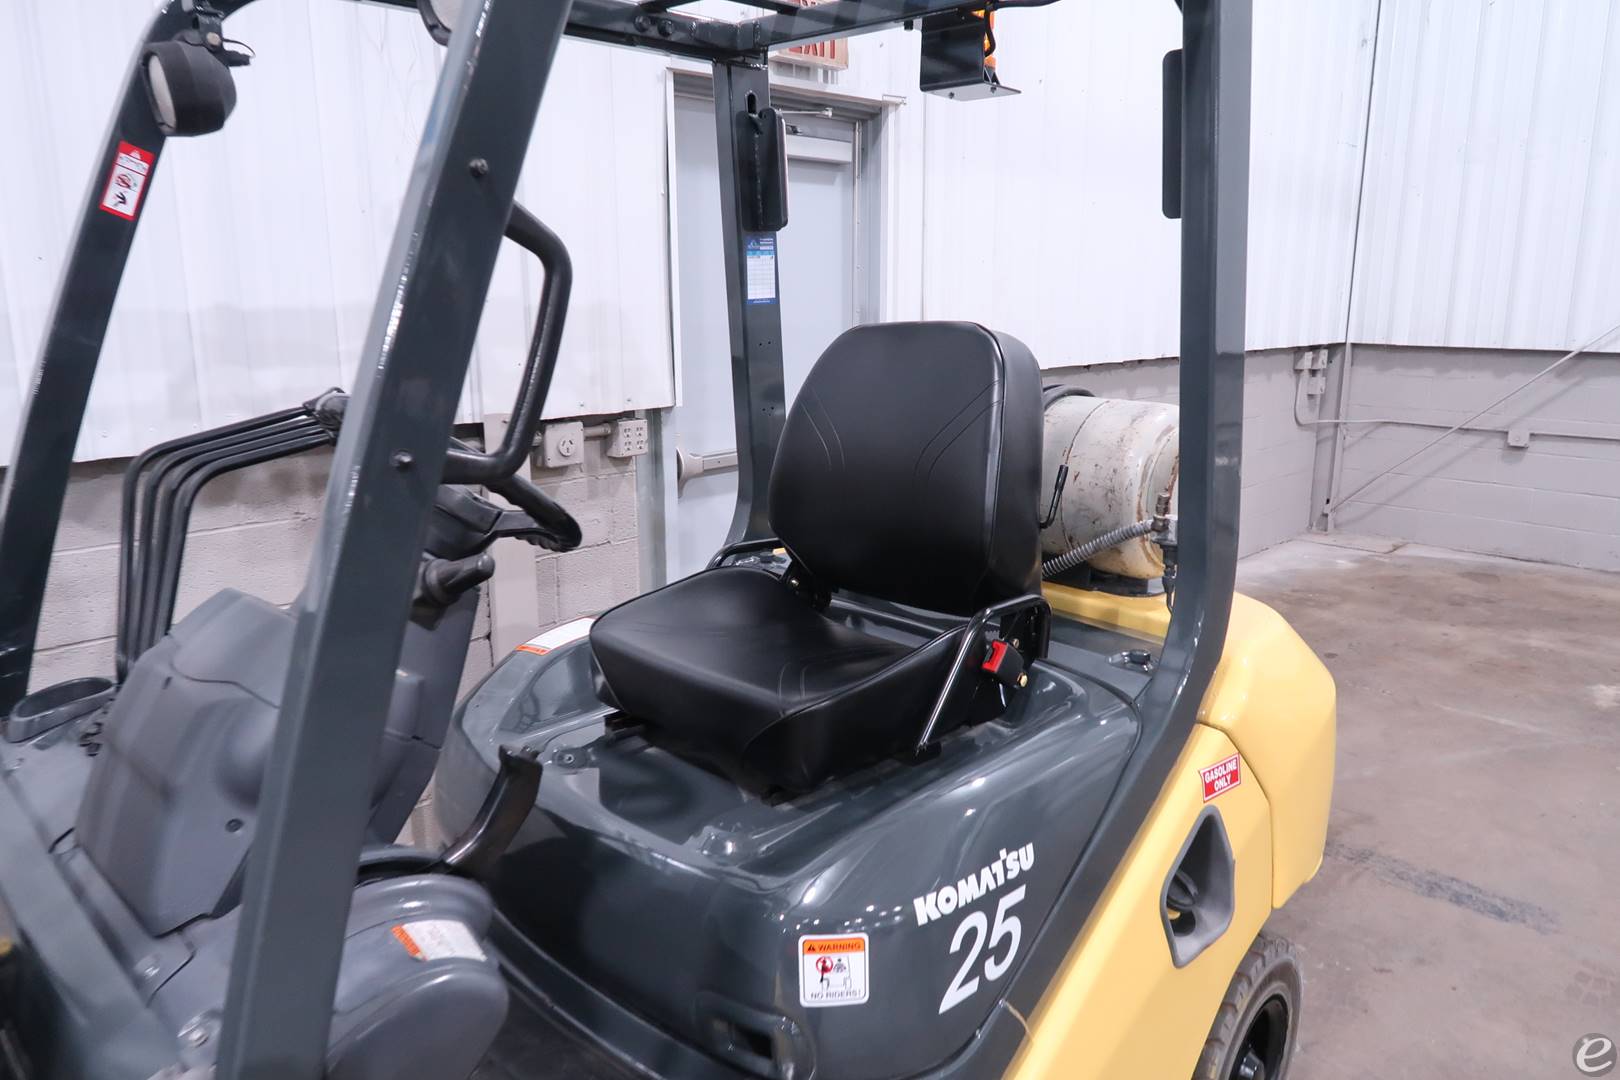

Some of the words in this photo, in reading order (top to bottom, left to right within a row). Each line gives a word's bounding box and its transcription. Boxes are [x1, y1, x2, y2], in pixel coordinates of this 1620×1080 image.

[1204, 759, 1238, 783] GASOLINE
[1214, 773, 1232, 792] ONLY
[913, 842, 1035, 927] KOMATSU
[818, 942, 861, 951] WARNING
[938, 884, 1026, 1015] 25
[810, 991, 824, 999] NO
[825, 989, 861, 998] RIDERS!
